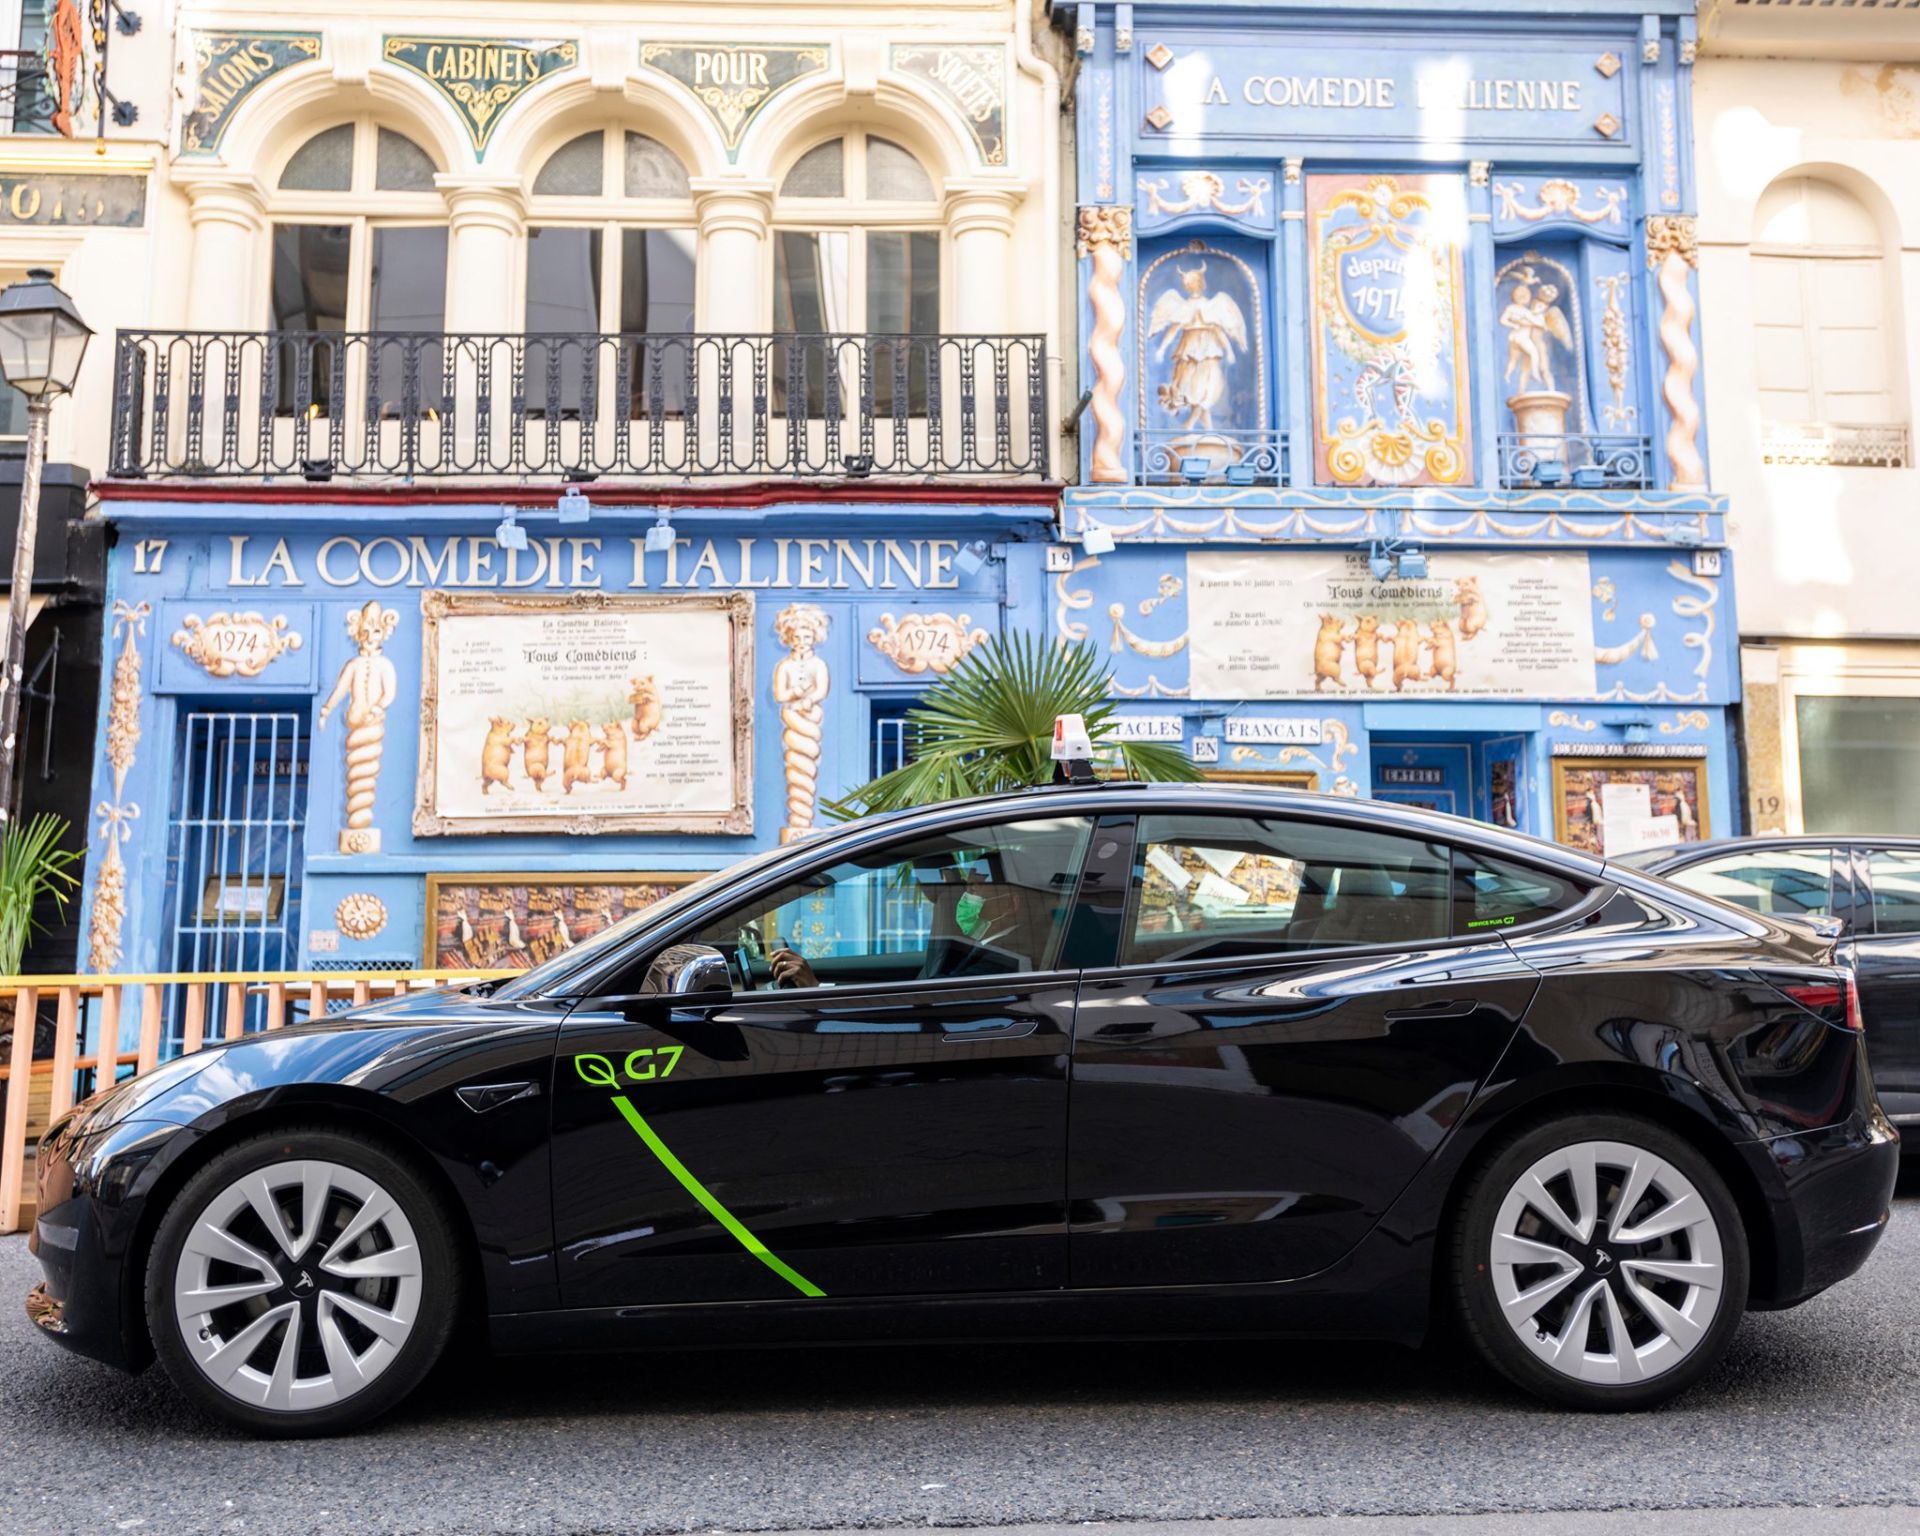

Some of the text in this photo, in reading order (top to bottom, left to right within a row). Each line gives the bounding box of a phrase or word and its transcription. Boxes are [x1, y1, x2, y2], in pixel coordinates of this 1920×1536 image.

[426, 46, 540, 81] CABINETS
[695, 52, 769, 84] POUR
[197, 41, 274, 123] SALONS
[1202, 76, 1581, 111] A COMEDIE LIENNE
[1347, 256, 1406, 280] depui
[134, 539, 168, 573] 17
[227, 536, 959, 589] LA COMEDIE ITALIENNE
[1051, 552, 1071, 566] 19
[1700, 554, 1718, 569] 19
[1327, 585, 1364, 600] Tous
[213, 631, 259, 653] 1974
[905, 630, 950, 653] 1974
[523, 649, 559, 663] Tous
[1228, 722, 1320, 739] FRANCAIS
[1196, 742, 1216, 756] EN
[1757, 796, 1780, 815] 19
[1503, 916, 1515, 925] G7
[624, 1045, 685, 1080] G7
